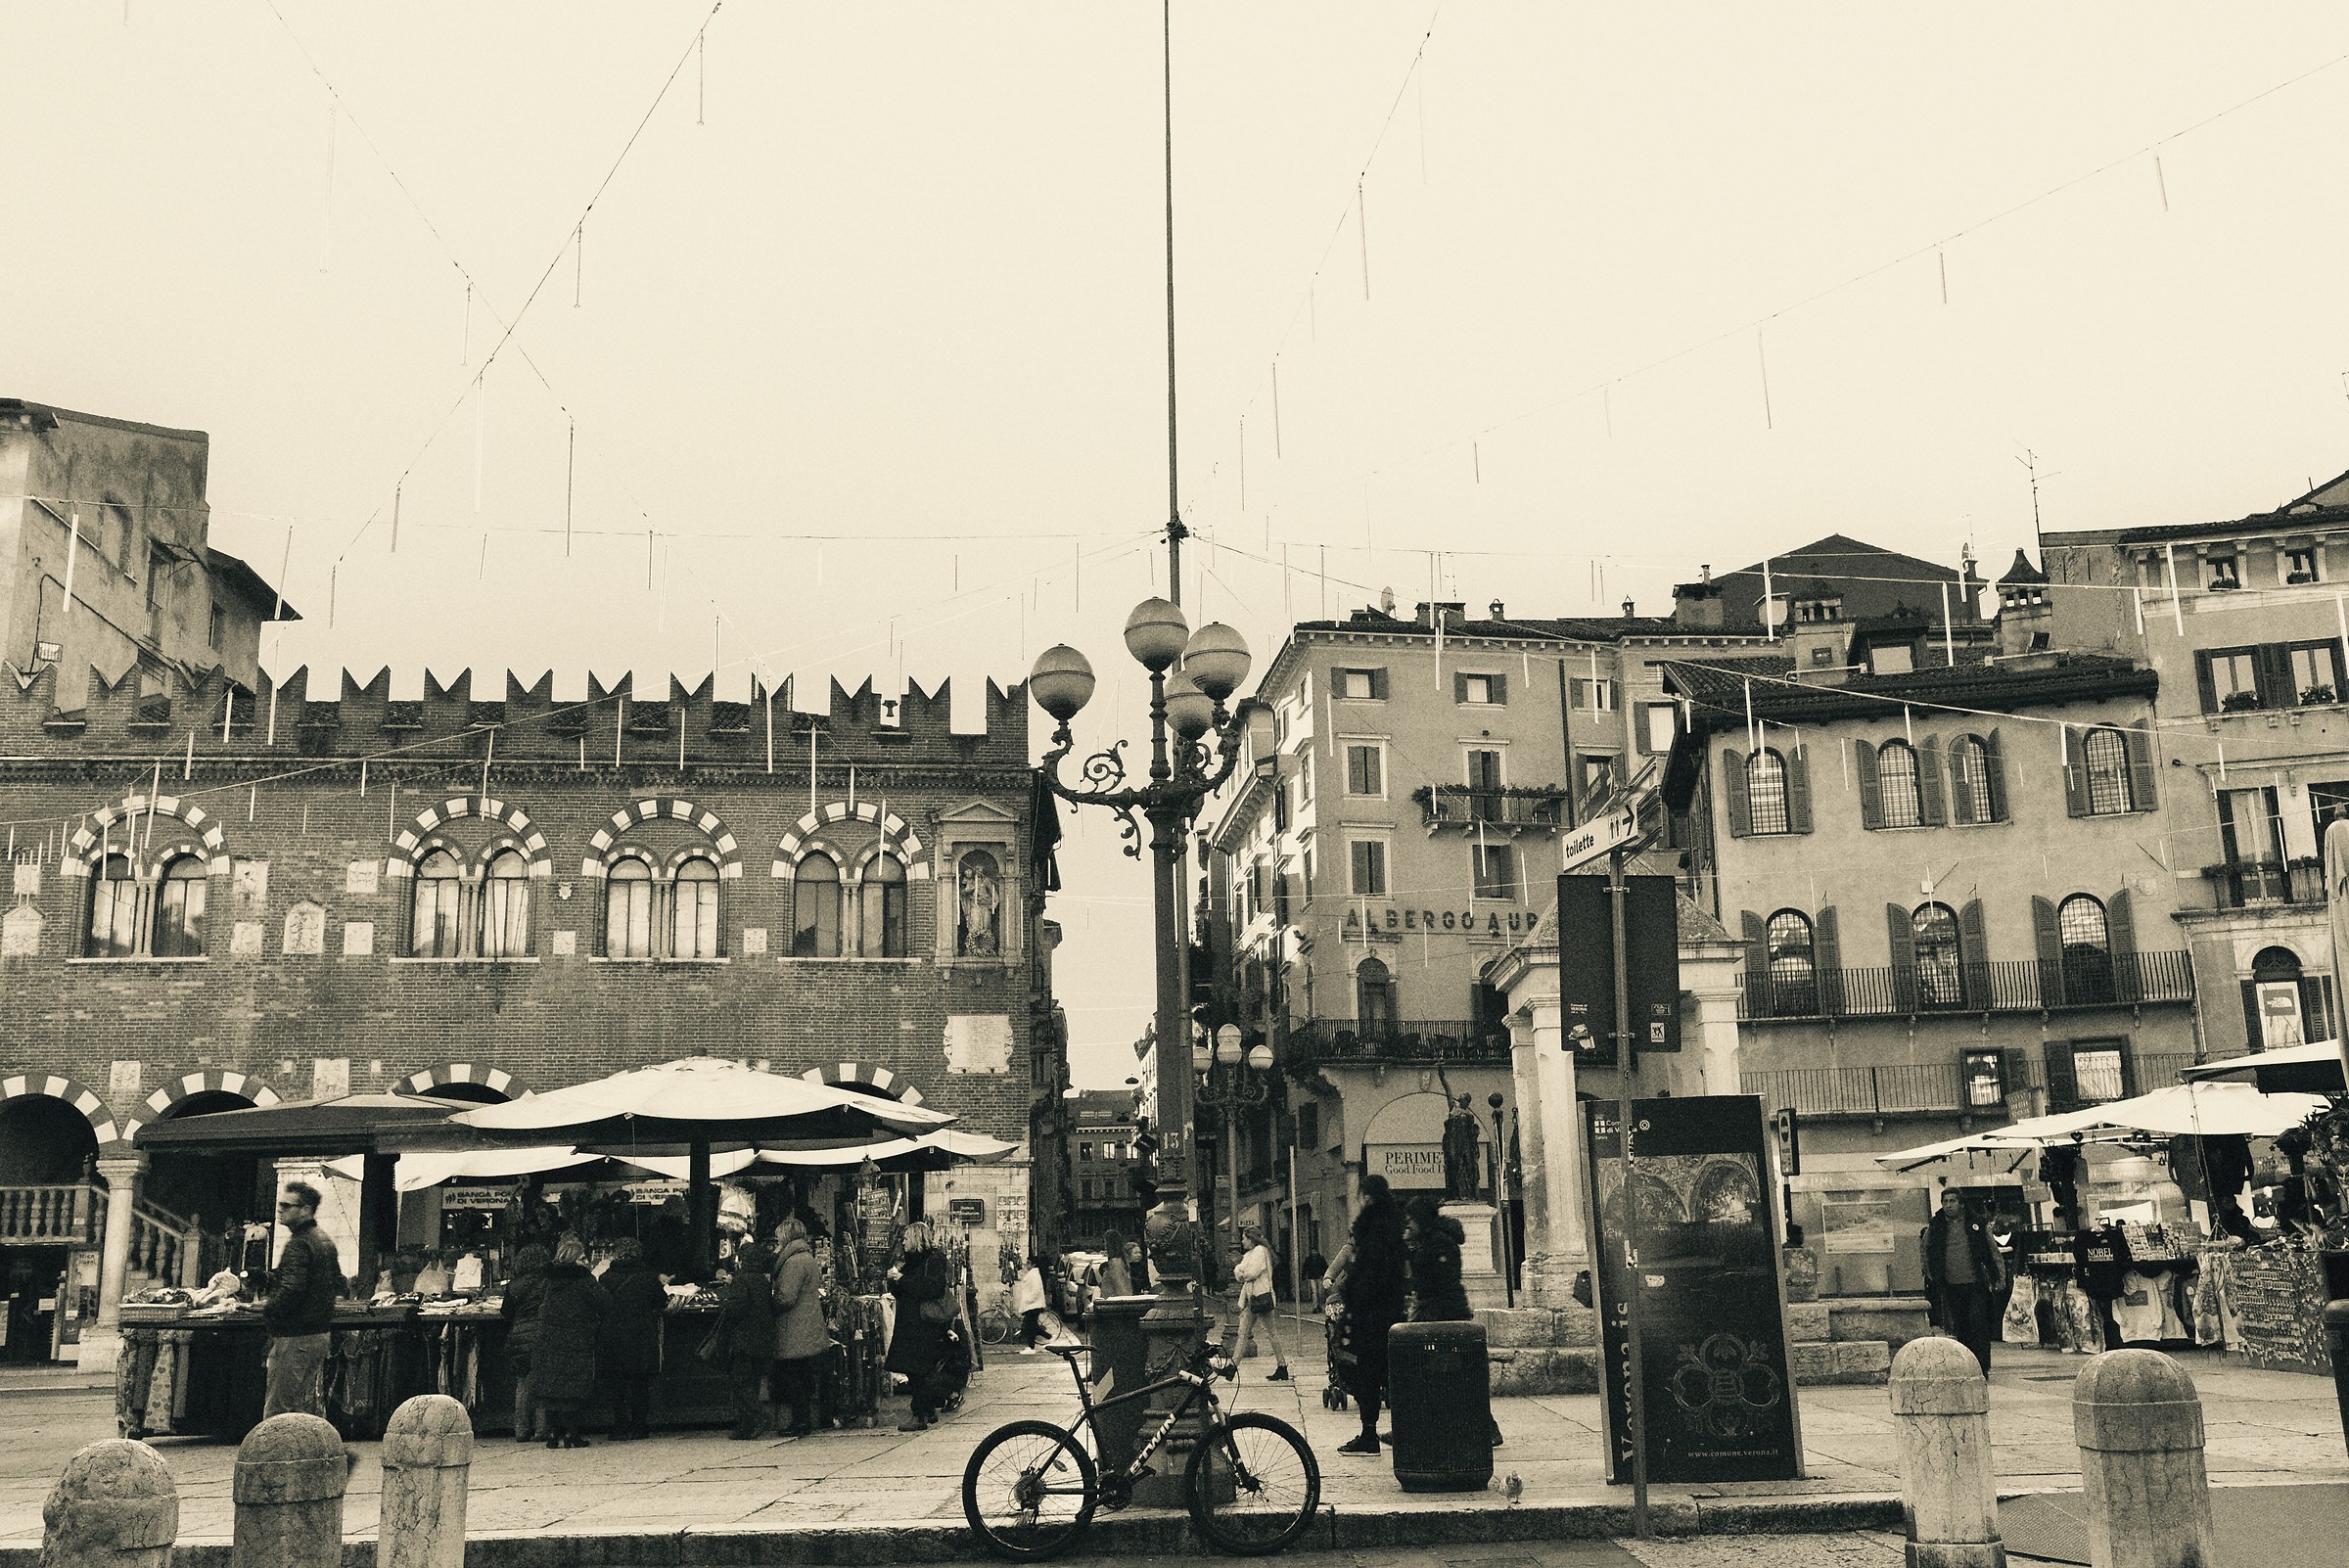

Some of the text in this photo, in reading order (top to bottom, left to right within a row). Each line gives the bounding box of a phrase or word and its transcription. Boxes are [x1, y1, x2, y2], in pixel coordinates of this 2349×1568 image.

[1566, 833, 1594, 858] toilette
[1347, 908, 1539, 931] ALBERGO AUR
[1164, 1132, 1178, 1149] 13
[1386, 1151, 1444, 1164] PERIME
[1385, 1165, 1409, 1174] Good
[1412, 1165, 1435, 1174] Food
[2087, 1248, 2113, 1257] NOBEL
[1687, 1449, 1778, 1457] www.comune.verona.it
